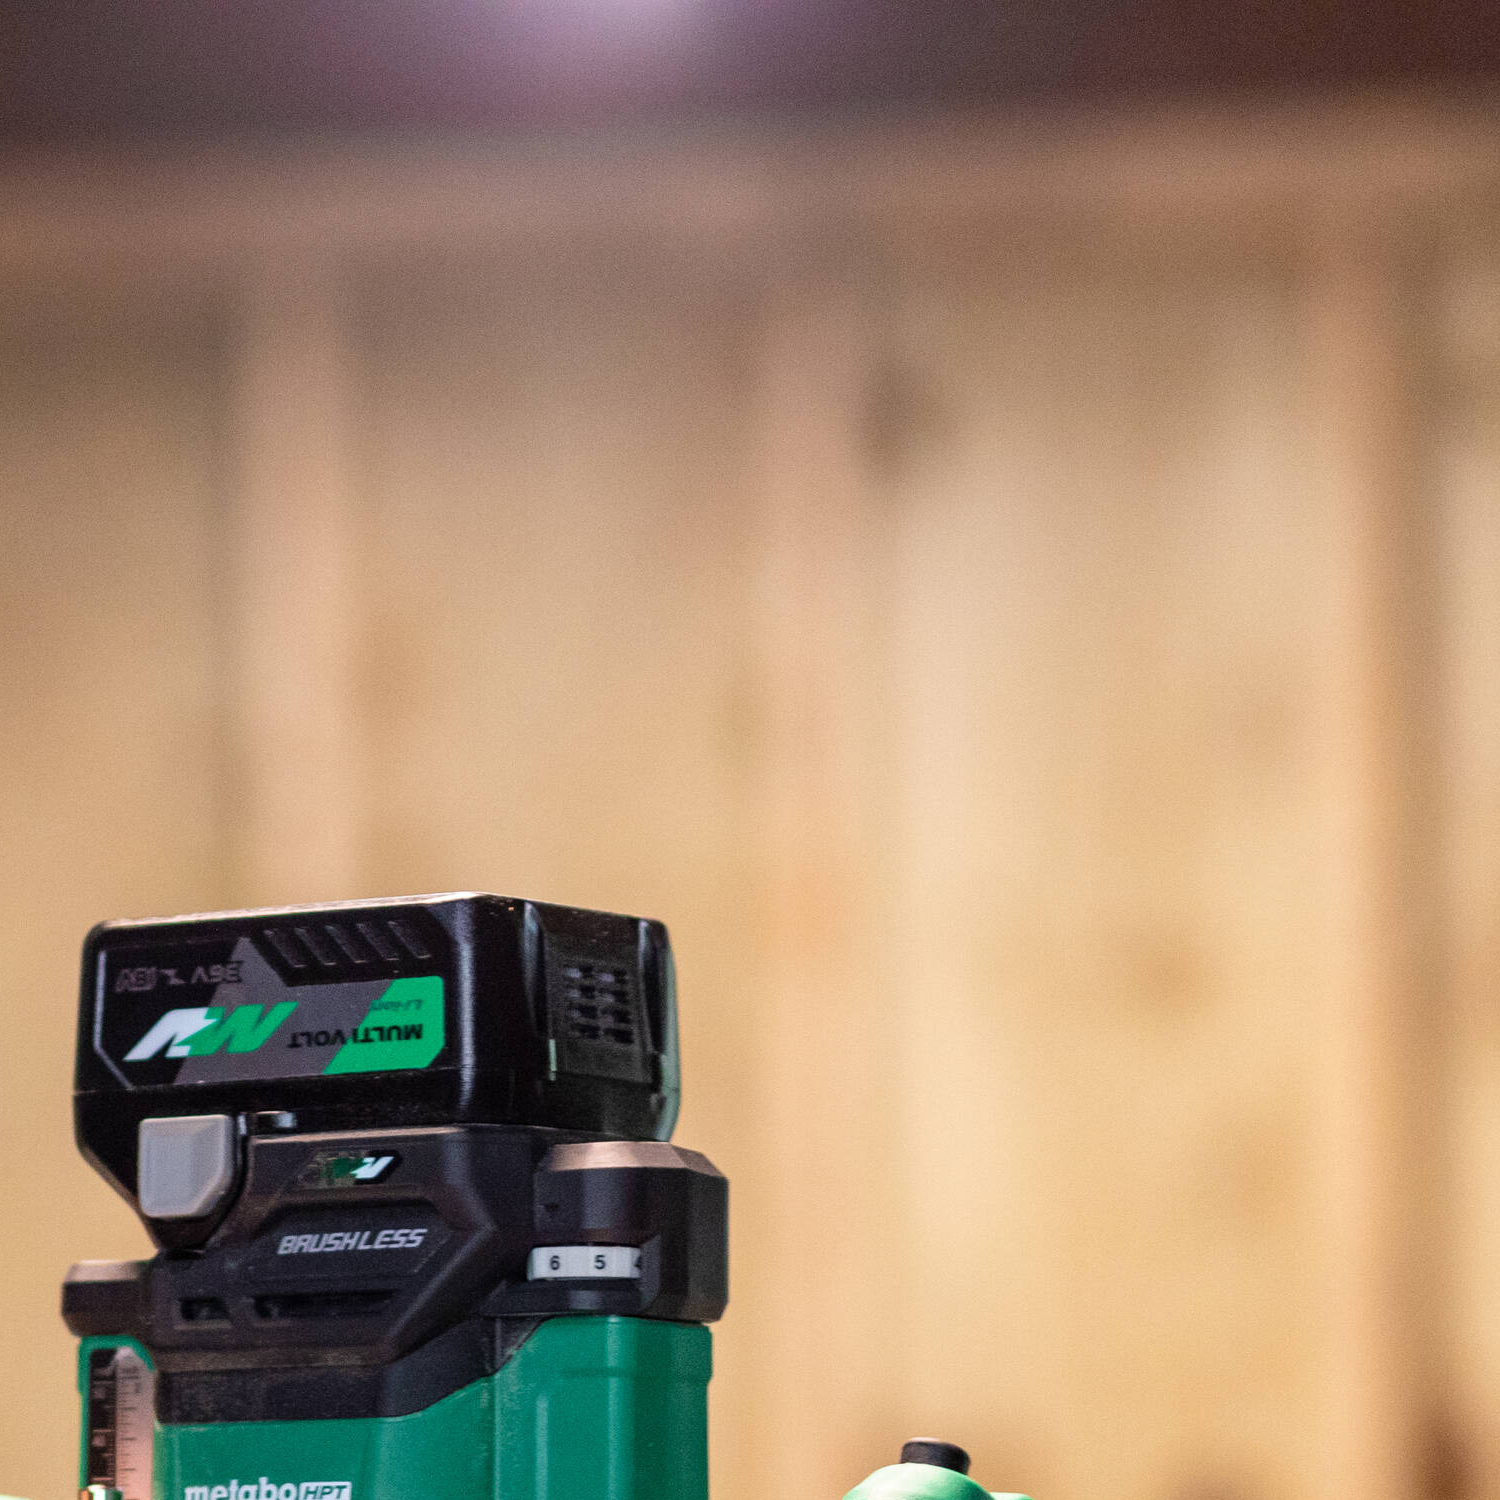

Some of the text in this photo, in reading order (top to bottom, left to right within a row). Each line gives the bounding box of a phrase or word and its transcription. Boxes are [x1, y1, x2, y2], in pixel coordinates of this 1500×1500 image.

[286, 1023, 424, 1049] MULTI VOLT
[277, 1228, 428, 1255] BRUSHLESS
[549, 1255, 560, 1270] 6
[594, 1254, 606, 1270] 5
